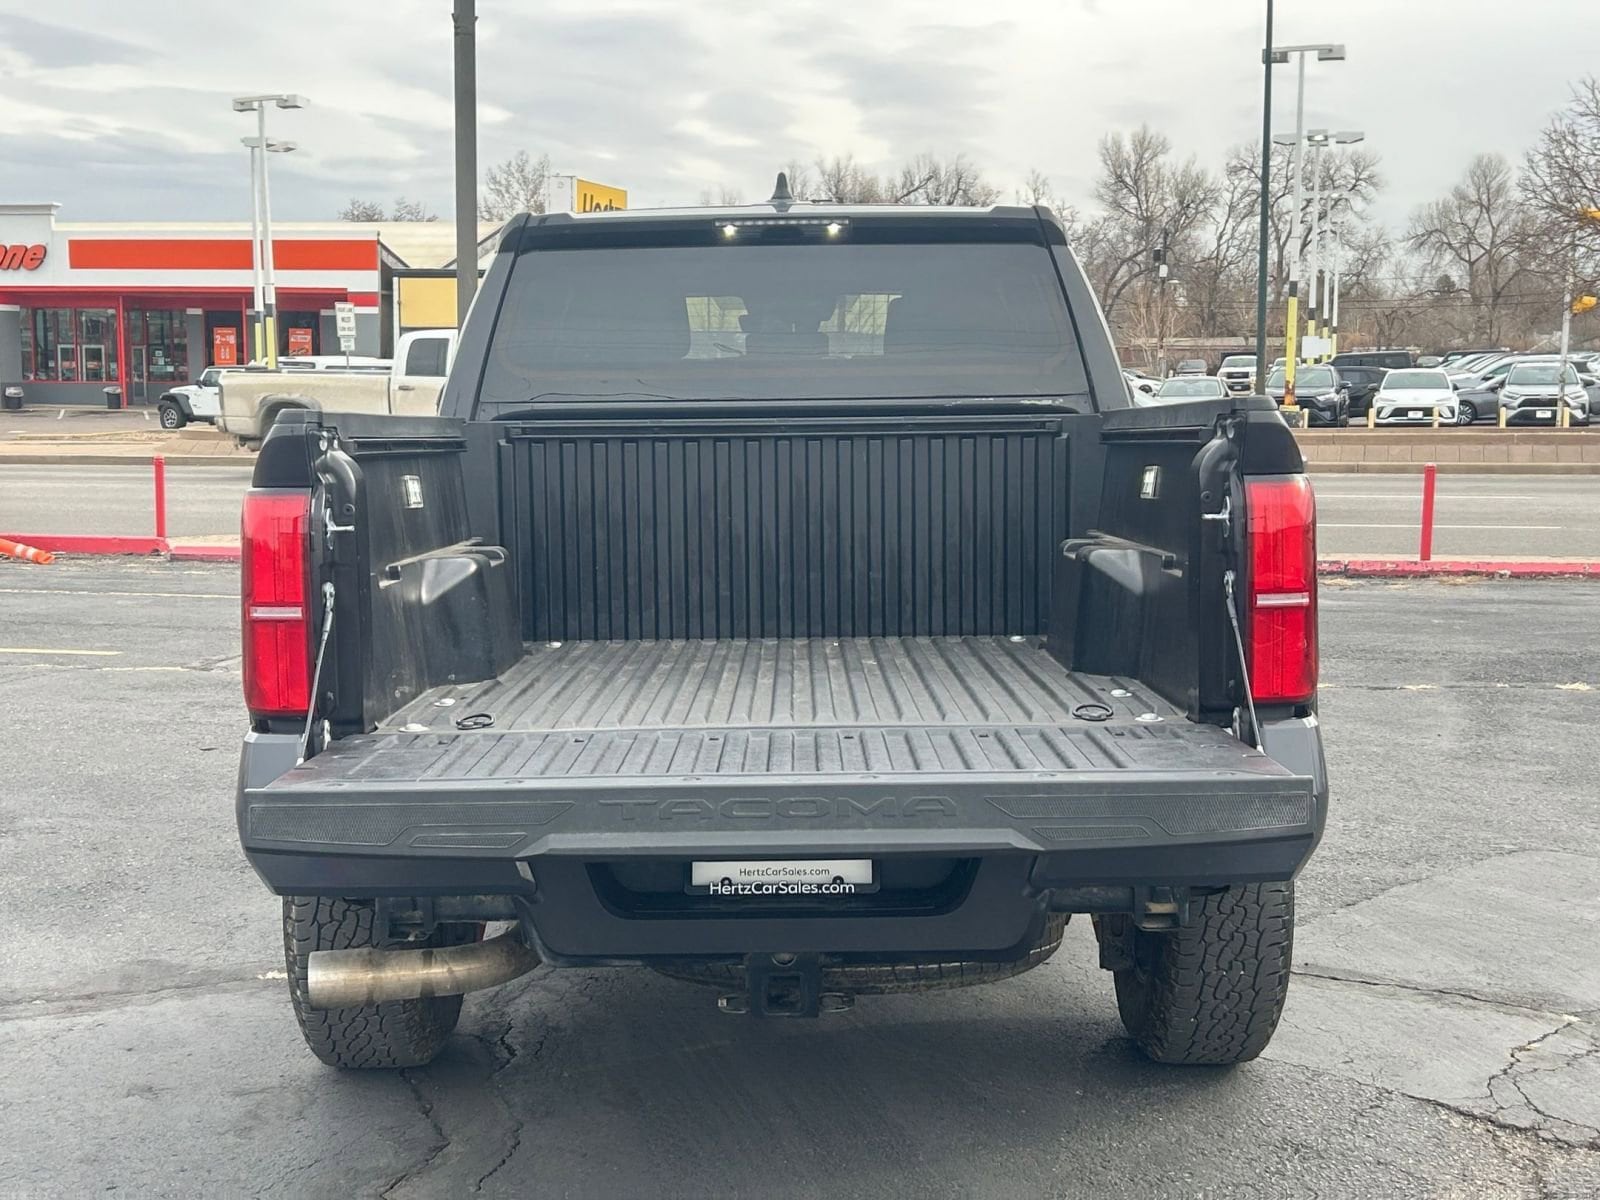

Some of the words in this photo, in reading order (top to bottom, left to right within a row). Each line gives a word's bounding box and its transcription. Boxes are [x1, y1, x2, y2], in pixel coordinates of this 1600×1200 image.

[599, 796, 957, 820] TACOMA
[739, 867, 830, 877] HertzCarSales.com
[709, 881, 855, 895] HertzCarSales.com
